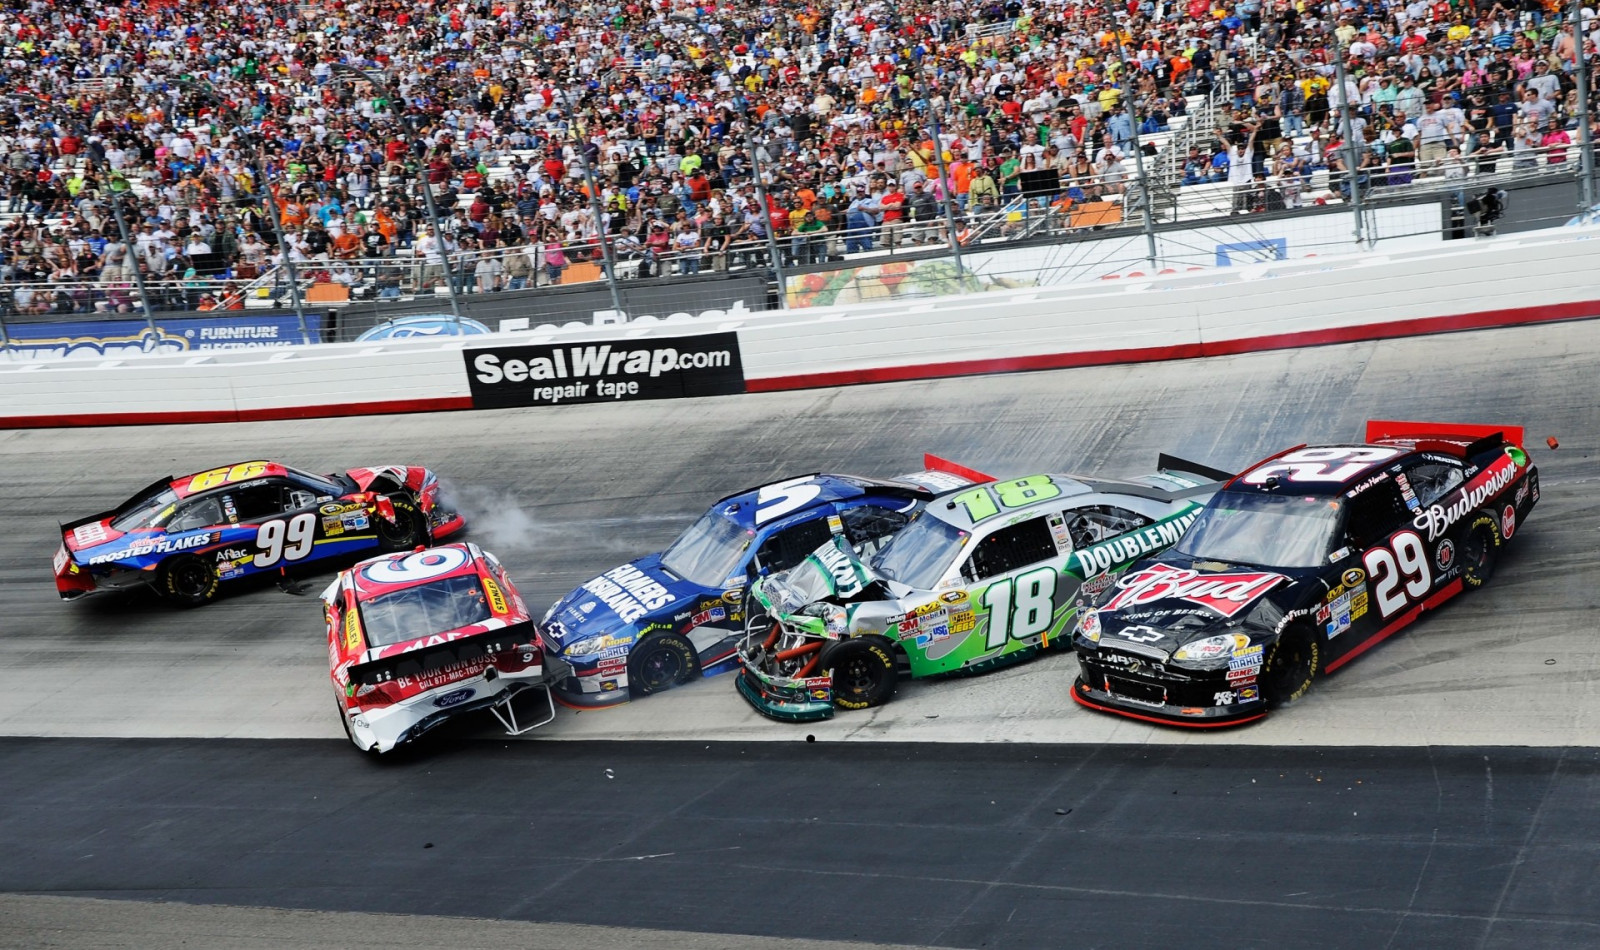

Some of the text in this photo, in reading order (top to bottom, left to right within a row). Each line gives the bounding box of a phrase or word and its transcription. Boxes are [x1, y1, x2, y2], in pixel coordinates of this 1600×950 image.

[200, 326, 279, 340] FURNITURE
[533, 379, 639, 403] repair tape
[755, 474, 822, 526] 5
[953, 474, 1062, 524] 18
[1413, 460, 1518, 543] Budweiser
[88, 532, 211, 567] FROSTED FLAKES
[253, 513, 317, 568] 99
[603, 563, 677, 611] FARMERS
[1363, 530, 1431, 621] 29
[487, 580, 505, 611] STANLEY
[1116, 570, 1284, 612] Bud
[693, 610, 711, 626] 3M
[982, 565, 1059, 652] 18
[898, 618, 918, 632] 3M
[933, 625, 948, 636] USG
[949, 620, 975, 634] JEGS
[522, 652, 534, 663] 9
[600, 646, 628, 659] MAHLE
[868, 645, 892, 668] EAGLE
[1229, 656, 1263, 669] MAHLE
[397, 676, 414, 689] BE
[1227, 668, 1253, 678] COMP
[440, 691, 468, 706] Ford
